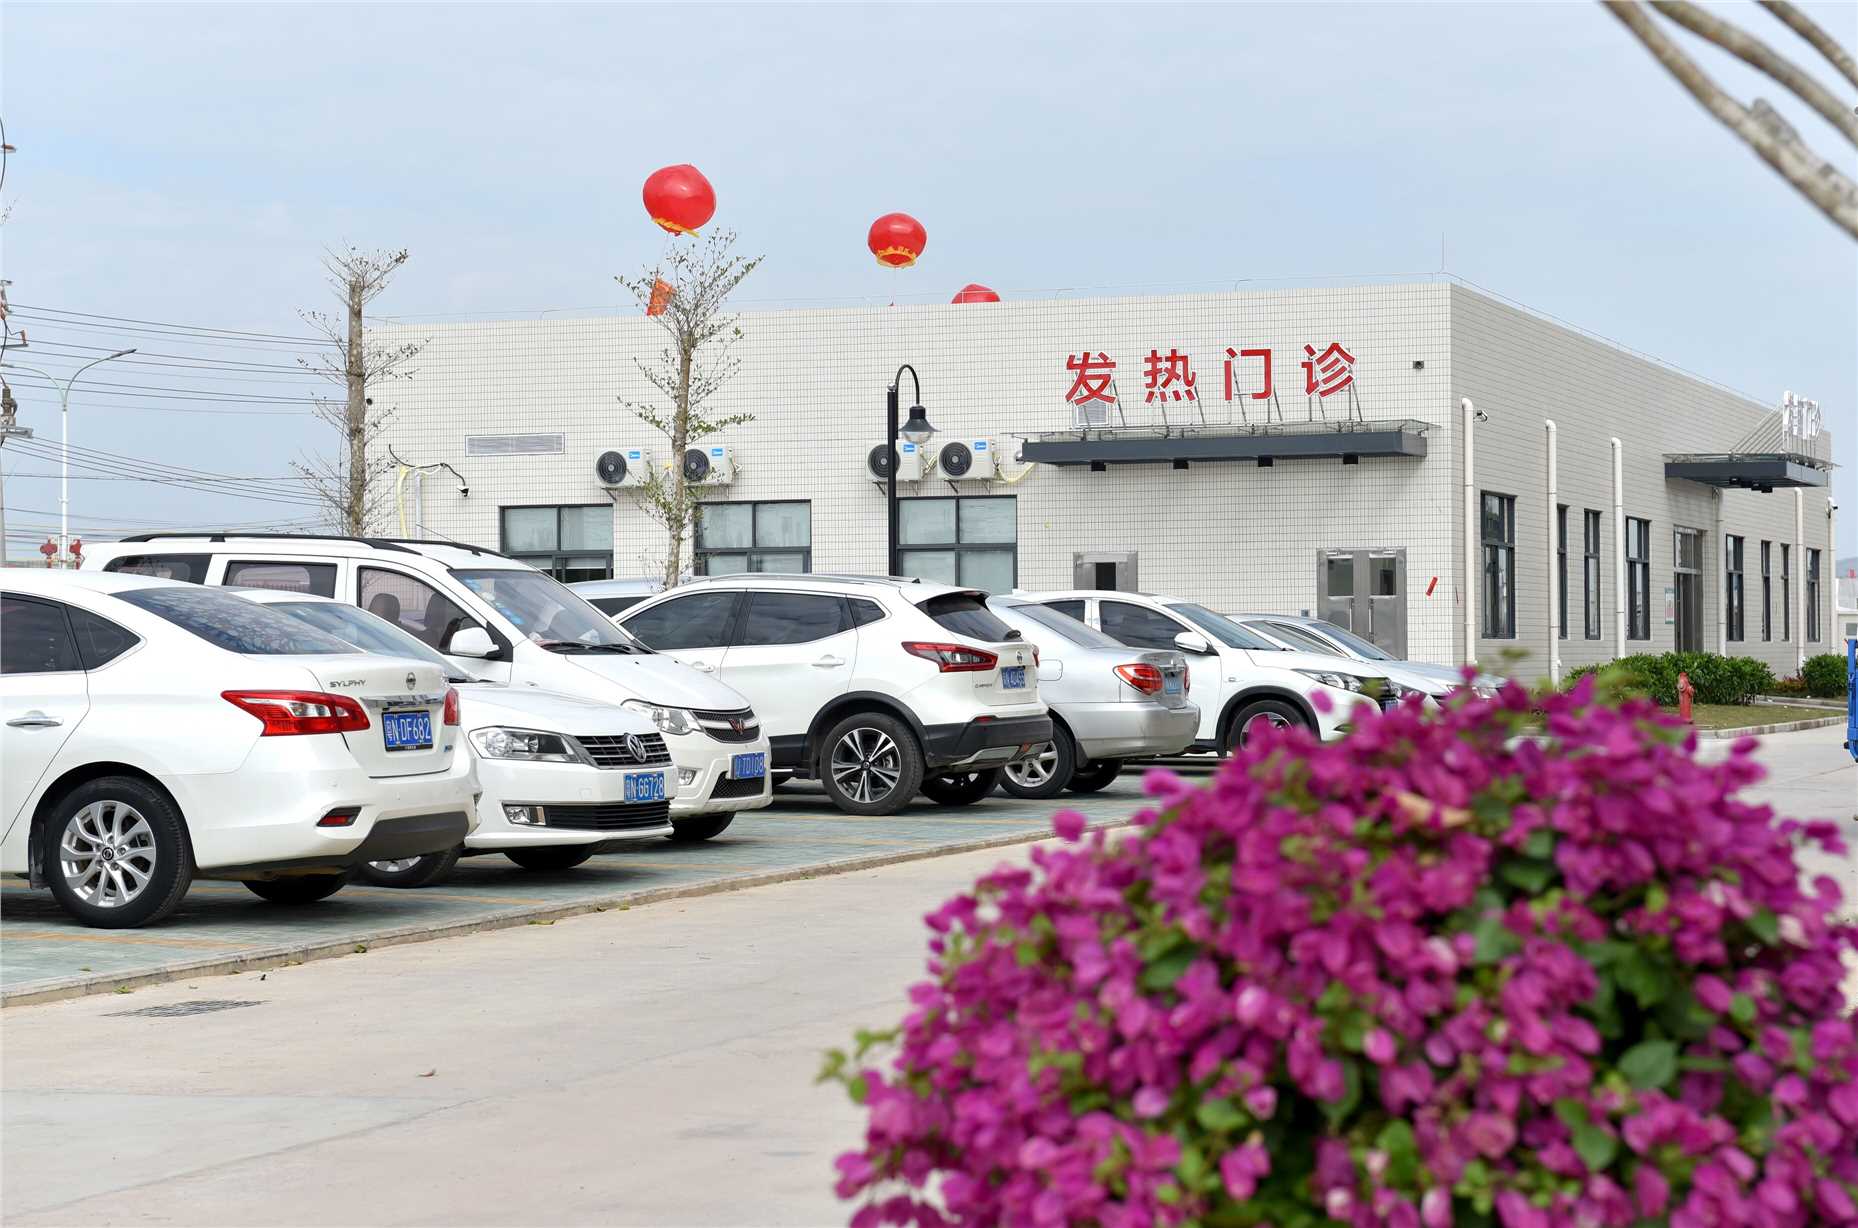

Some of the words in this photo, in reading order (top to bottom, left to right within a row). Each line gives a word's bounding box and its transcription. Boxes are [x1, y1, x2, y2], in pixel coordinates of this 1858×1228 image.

[1065, 342, 1356, 406] 发热门诊
[330, 679, 366, 688] SYLPHY
